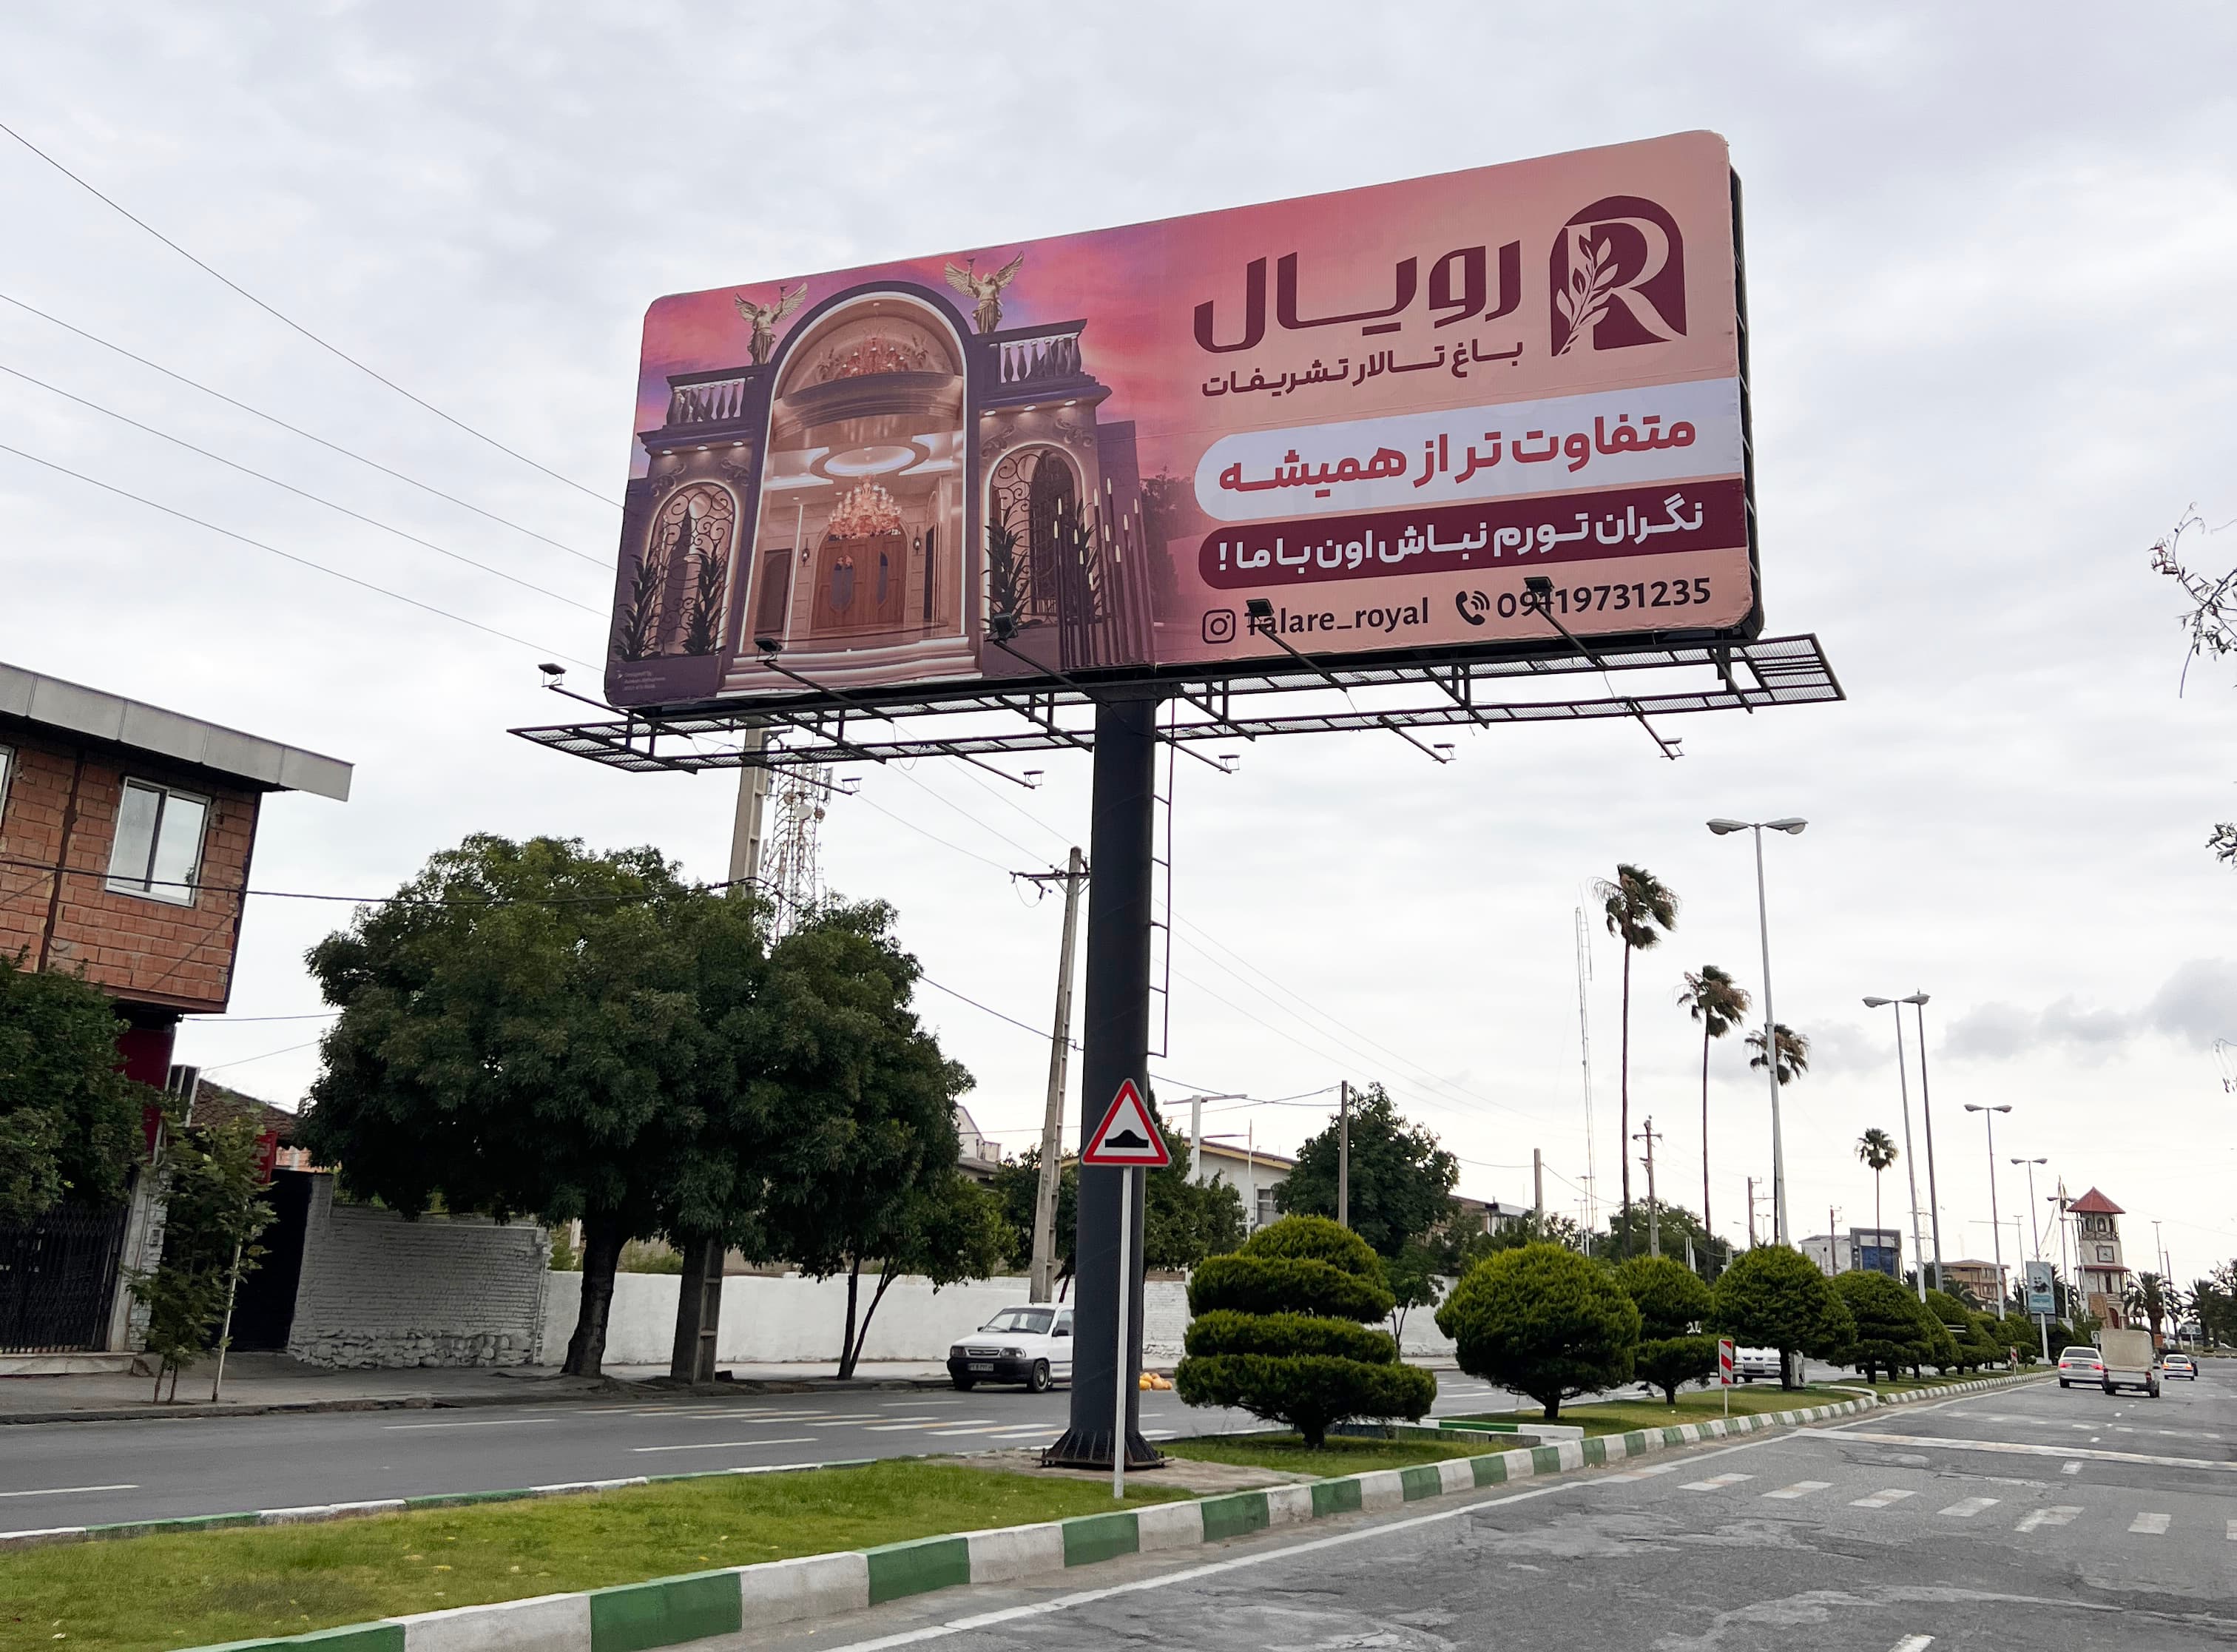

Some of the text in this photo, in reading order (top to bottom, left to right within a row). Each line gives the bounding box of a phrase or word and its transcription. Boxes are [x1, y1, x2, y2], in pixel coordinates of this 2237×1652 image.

[1193, 239, 1522, 354] رویال
[1201, 338, 1523, 397] باغ تالار تشریفات
[1218, 413, 1696, 499] متفاوت تر از همیشه
[1378, 522, 1488, 560] نباش
[1493, 512, 1589, 557] تورم
[1595, 492, 1704, 545] نگران
[1275, 537, 1311, 574] با
[1316, 530, 1373, 570] اون
[1497, 577, 1711, 618] 09119731235
